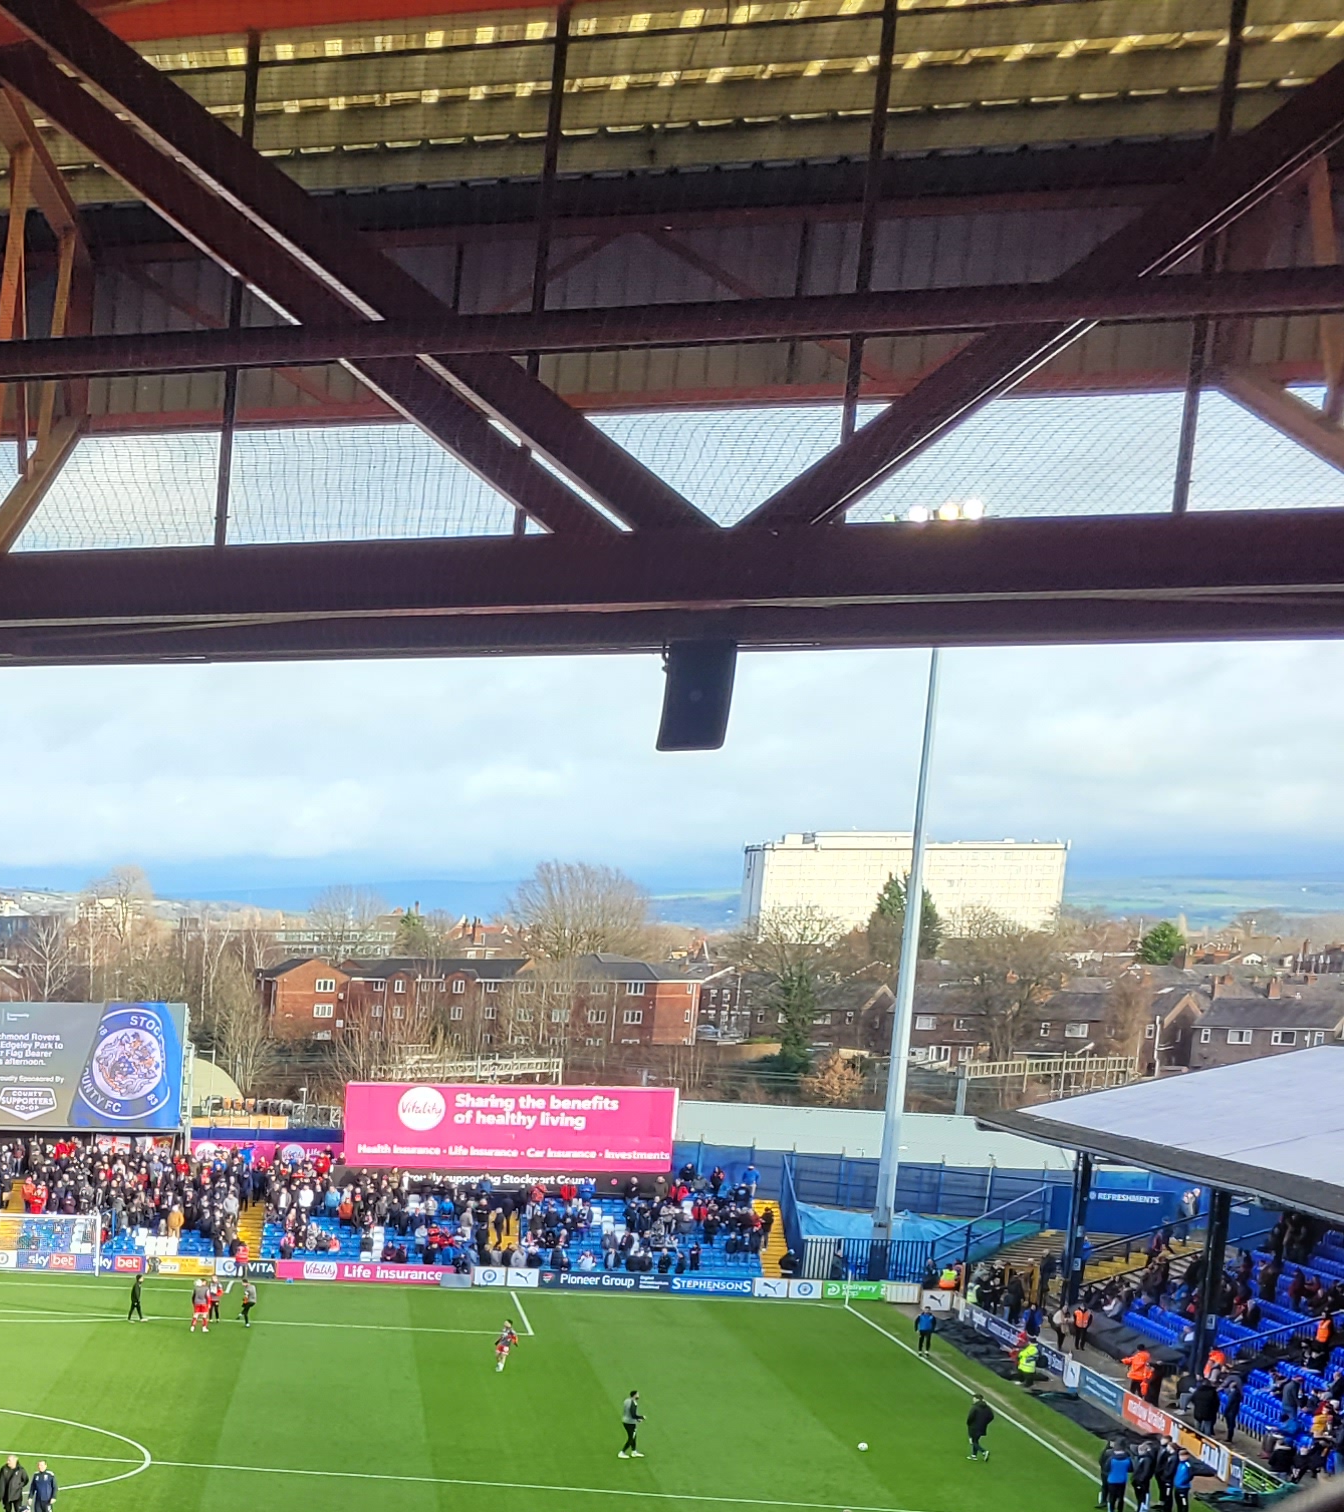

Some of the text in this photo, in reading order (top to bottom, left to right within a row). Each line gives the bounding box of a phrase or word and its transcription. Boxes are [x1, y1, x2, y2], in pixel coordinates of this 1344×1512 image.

[98, 1025, 108, 1036] 18
[31, 1033, 61, 1041] Rovers
[0, 1041, 32, 1050] Edgeley
[34, 1041, 53, 1049] Park
[55, 1042, 64, 1050] to
[5, 1050, 23, 1058] Flag
[4, 1058, 46, 1066] afternoon.
[19, 1075, 54, 1083] Sponsored
[1, 1097, 54, 1105] SUPPORTERS
[146, 1093, 159, 1106] 83
[455, 1093, 619, 1111] Sharing the benefits
[104, 1101, 122, 1113] FC
[401, 1100, 443, 1119] Vitality
[454, 1111, 586, 1130] of healthy living
[357, 1143, 391, 1154] Health
[526, 1147, 544, 1158] Car
[605, 1149, 670, 1160] Investments
[1097, 1193, 1159, 1204] REFRESHMENTS
[28, 1254, 75, 1268] sky bet
[117, 1256, 138, 1268] bet
[248, 1263, 275, 1273] VITA
[305, 1262, 442, 1281] Vitality Life insurance
[560, 1274, 600, 1286] Pioneer
[603, 1275, 635, 1288] Group
[672, 1279, 751, 1292] STEPHENSONS
